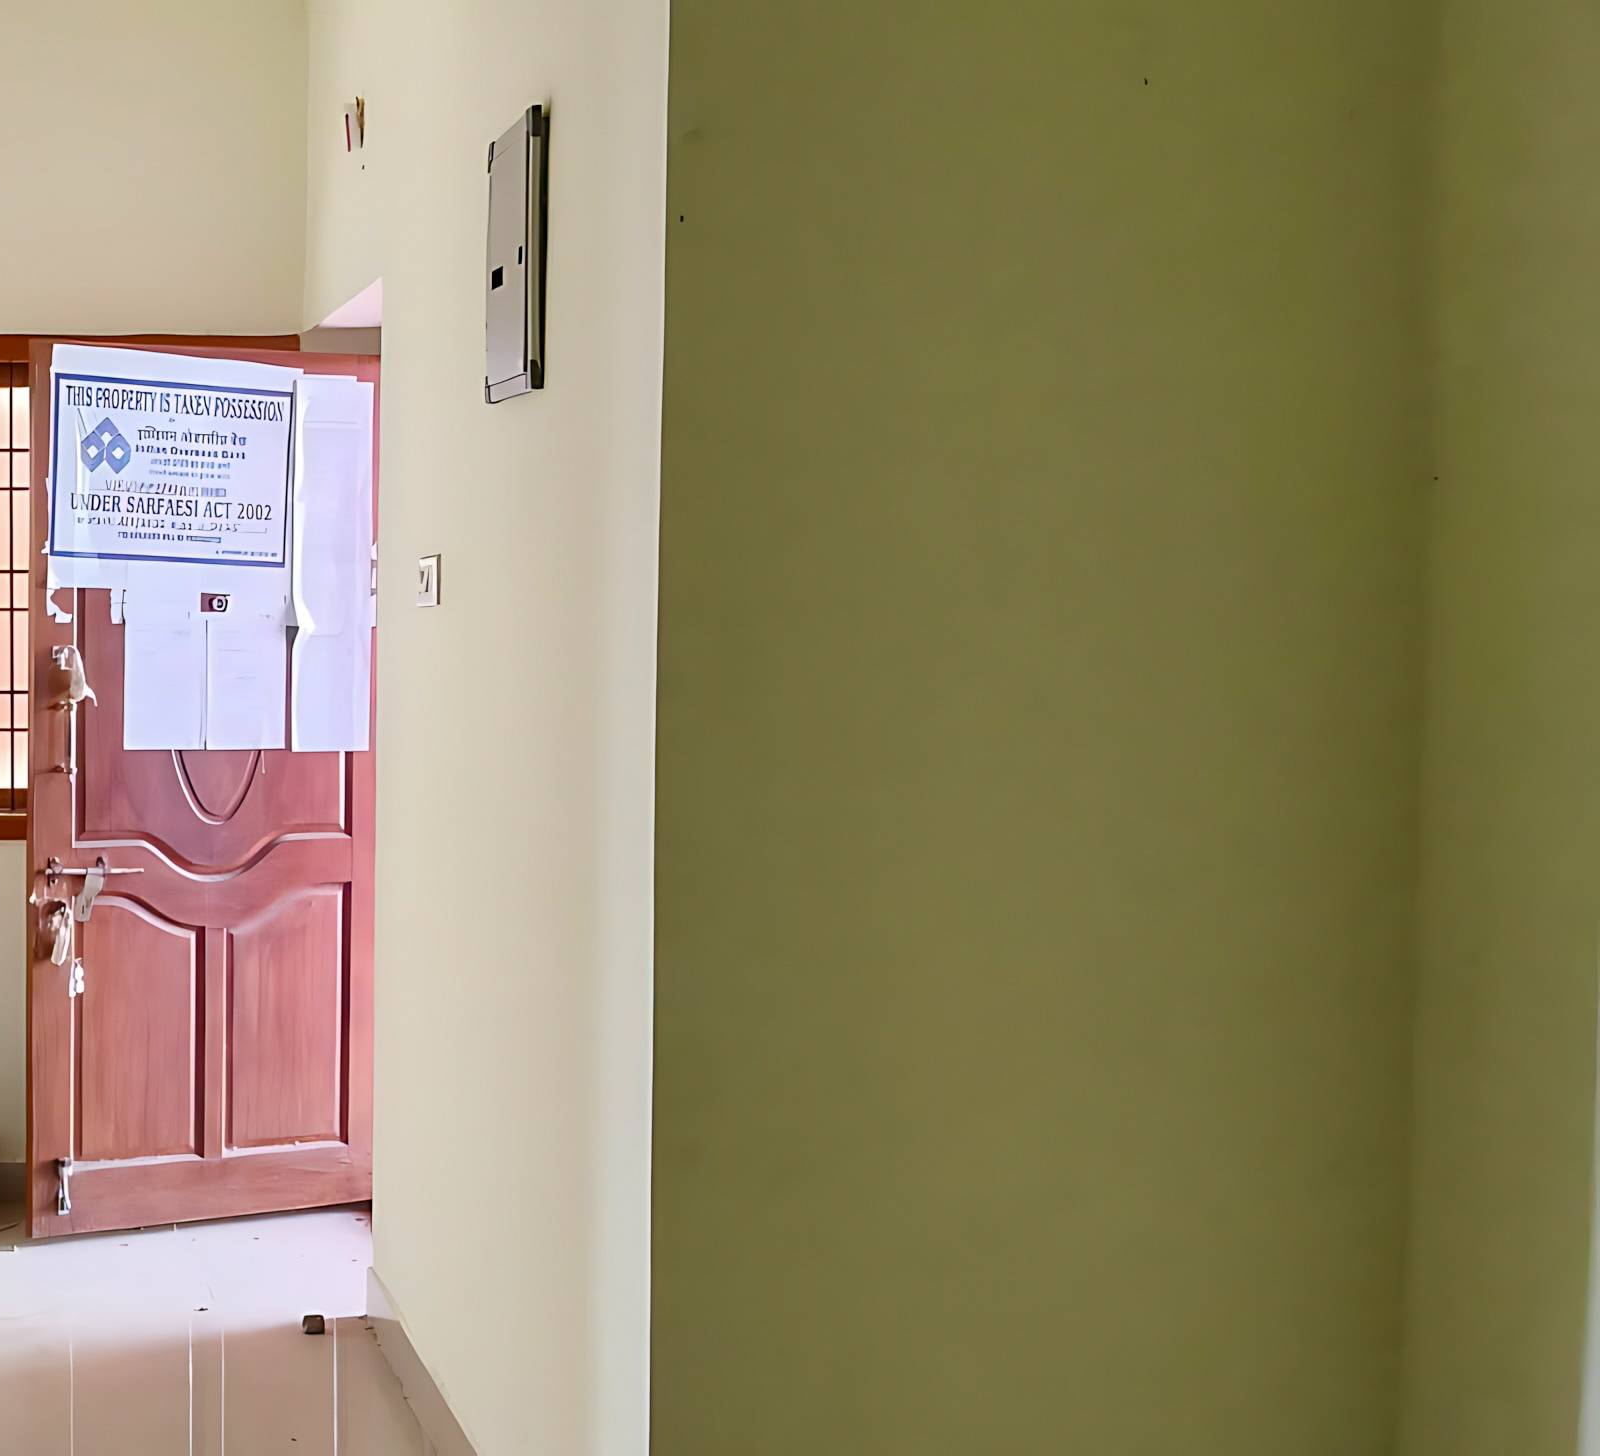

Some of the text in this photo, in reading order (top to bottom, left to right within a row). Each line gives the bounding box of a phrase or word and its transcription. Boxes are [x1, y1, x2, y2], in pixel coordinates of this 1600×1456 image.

[66, 385, 285, 422] THIS PROPERTY IS TAKEN POSSESSION
[70, 492, 273, 521] UNDER SARFAESI ACT 2002
